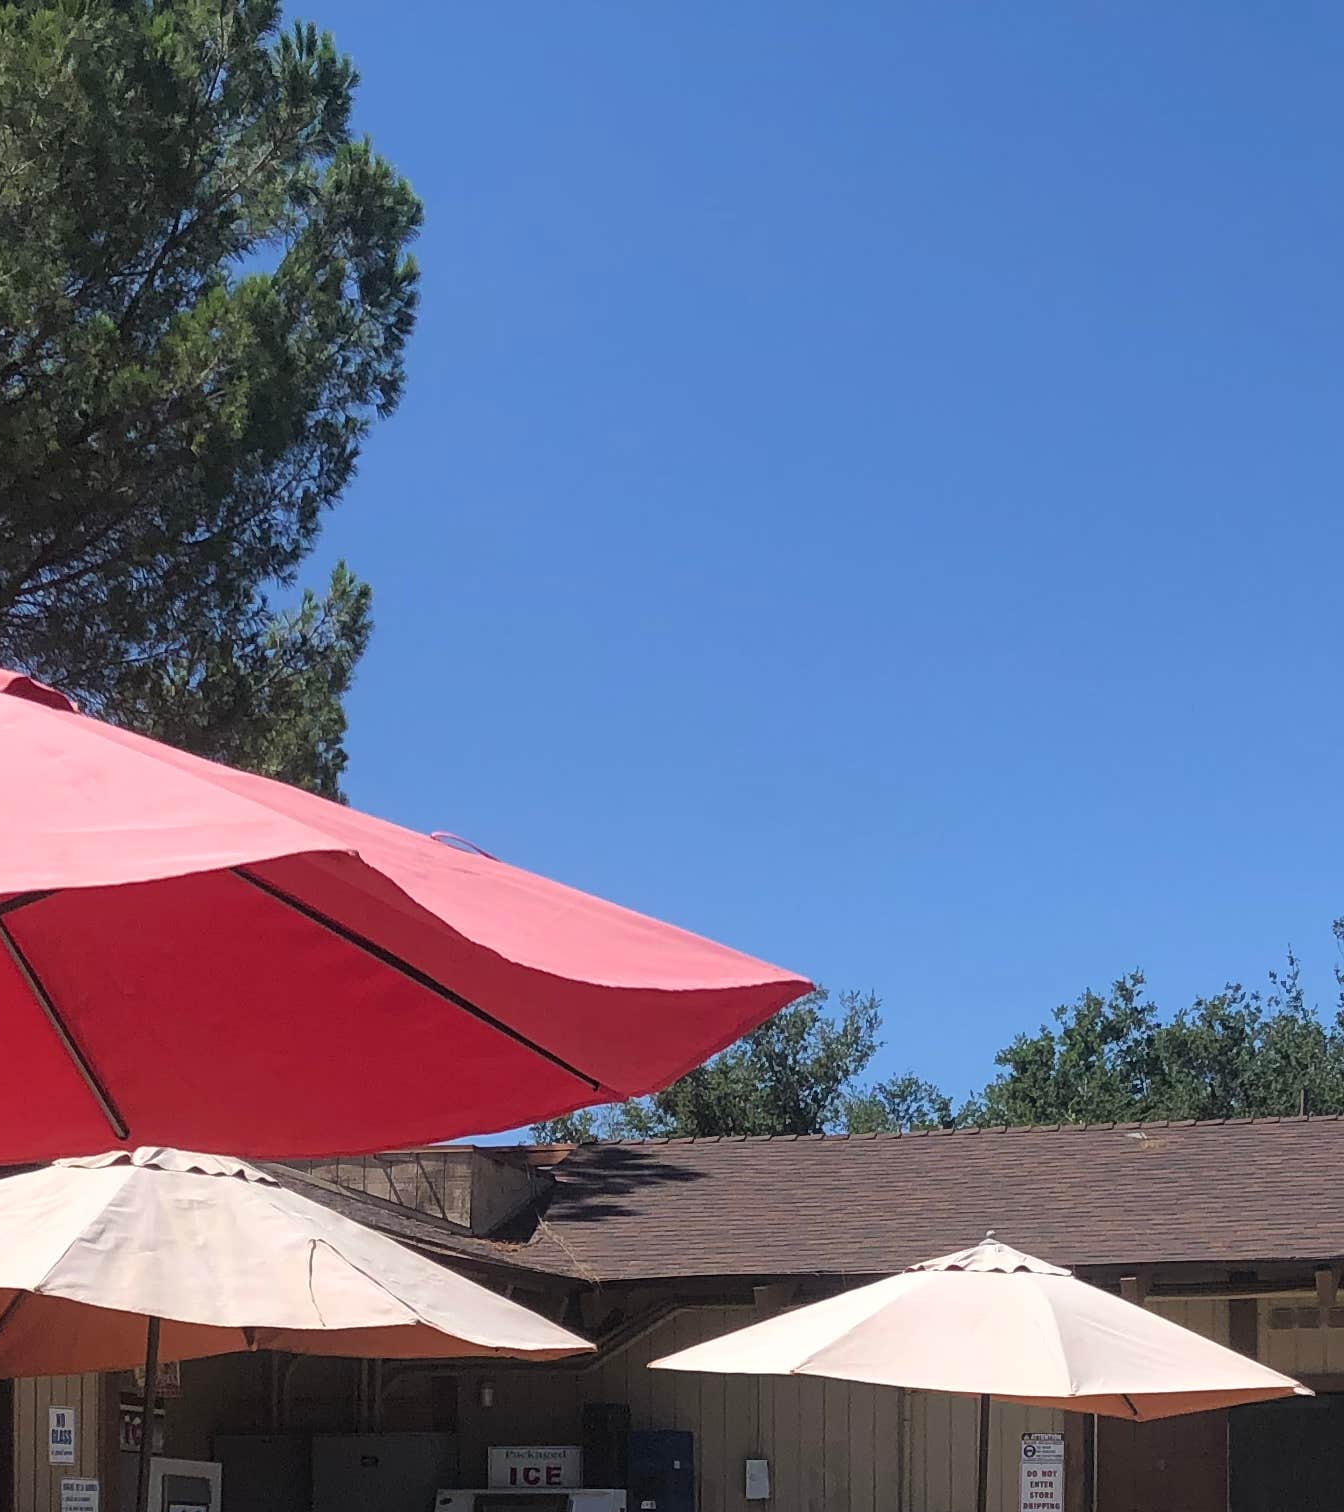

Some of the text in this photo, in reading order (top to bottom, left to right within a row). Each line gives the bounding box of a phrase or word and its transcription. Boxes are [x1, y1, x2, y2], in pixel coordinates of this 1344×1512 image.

[56, 1413, 65, 1428] NO
[51, 1429, 72, 1445] GLASS
[505, 1450, 567, 1460] Packaged
[510, 1466, 562, 1486] ICE
[1030, 1480, 1054, 1488] ENTER
[1029, 1491, 1054, 1499] STORE
[1023, 1502, 1061, 1510] DRIPPING
